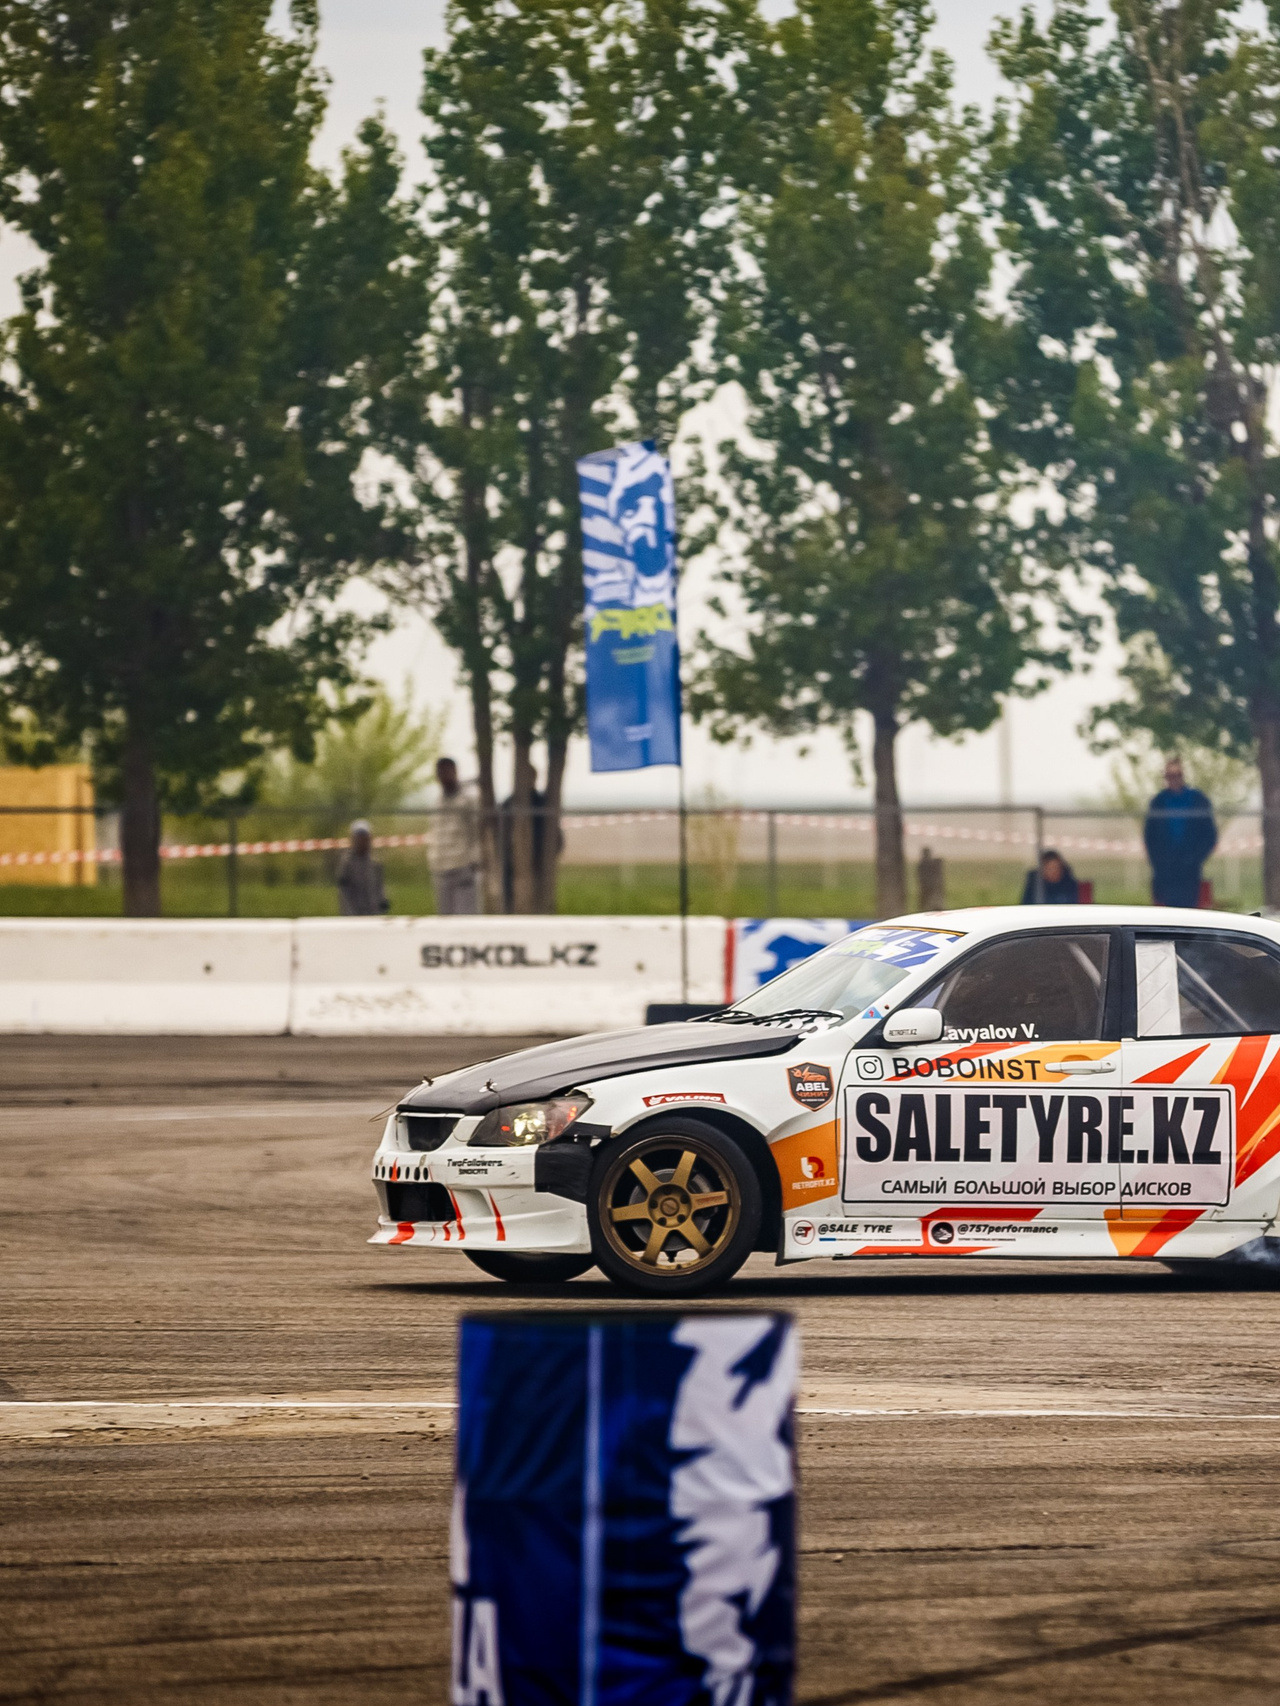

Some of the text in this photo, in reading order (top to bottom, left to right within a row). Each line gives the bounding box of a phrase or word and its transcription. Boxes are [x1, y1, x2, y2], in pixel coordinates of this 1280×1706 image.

[1020, 1023, 1039, 1039] V.
[892, 1057, 1041, 1081] BOBOINST
[795, 1082, 830, 1092] ABEL
[855, 1092, 1222, 1165] SALETYRE.KZ
[881, 1176, 1192, 1197] САМЫЙ БОЛЬШОЙ ВЫБОР ДИСКОВ
[957, 1223, 1059, 1235] @757performance
